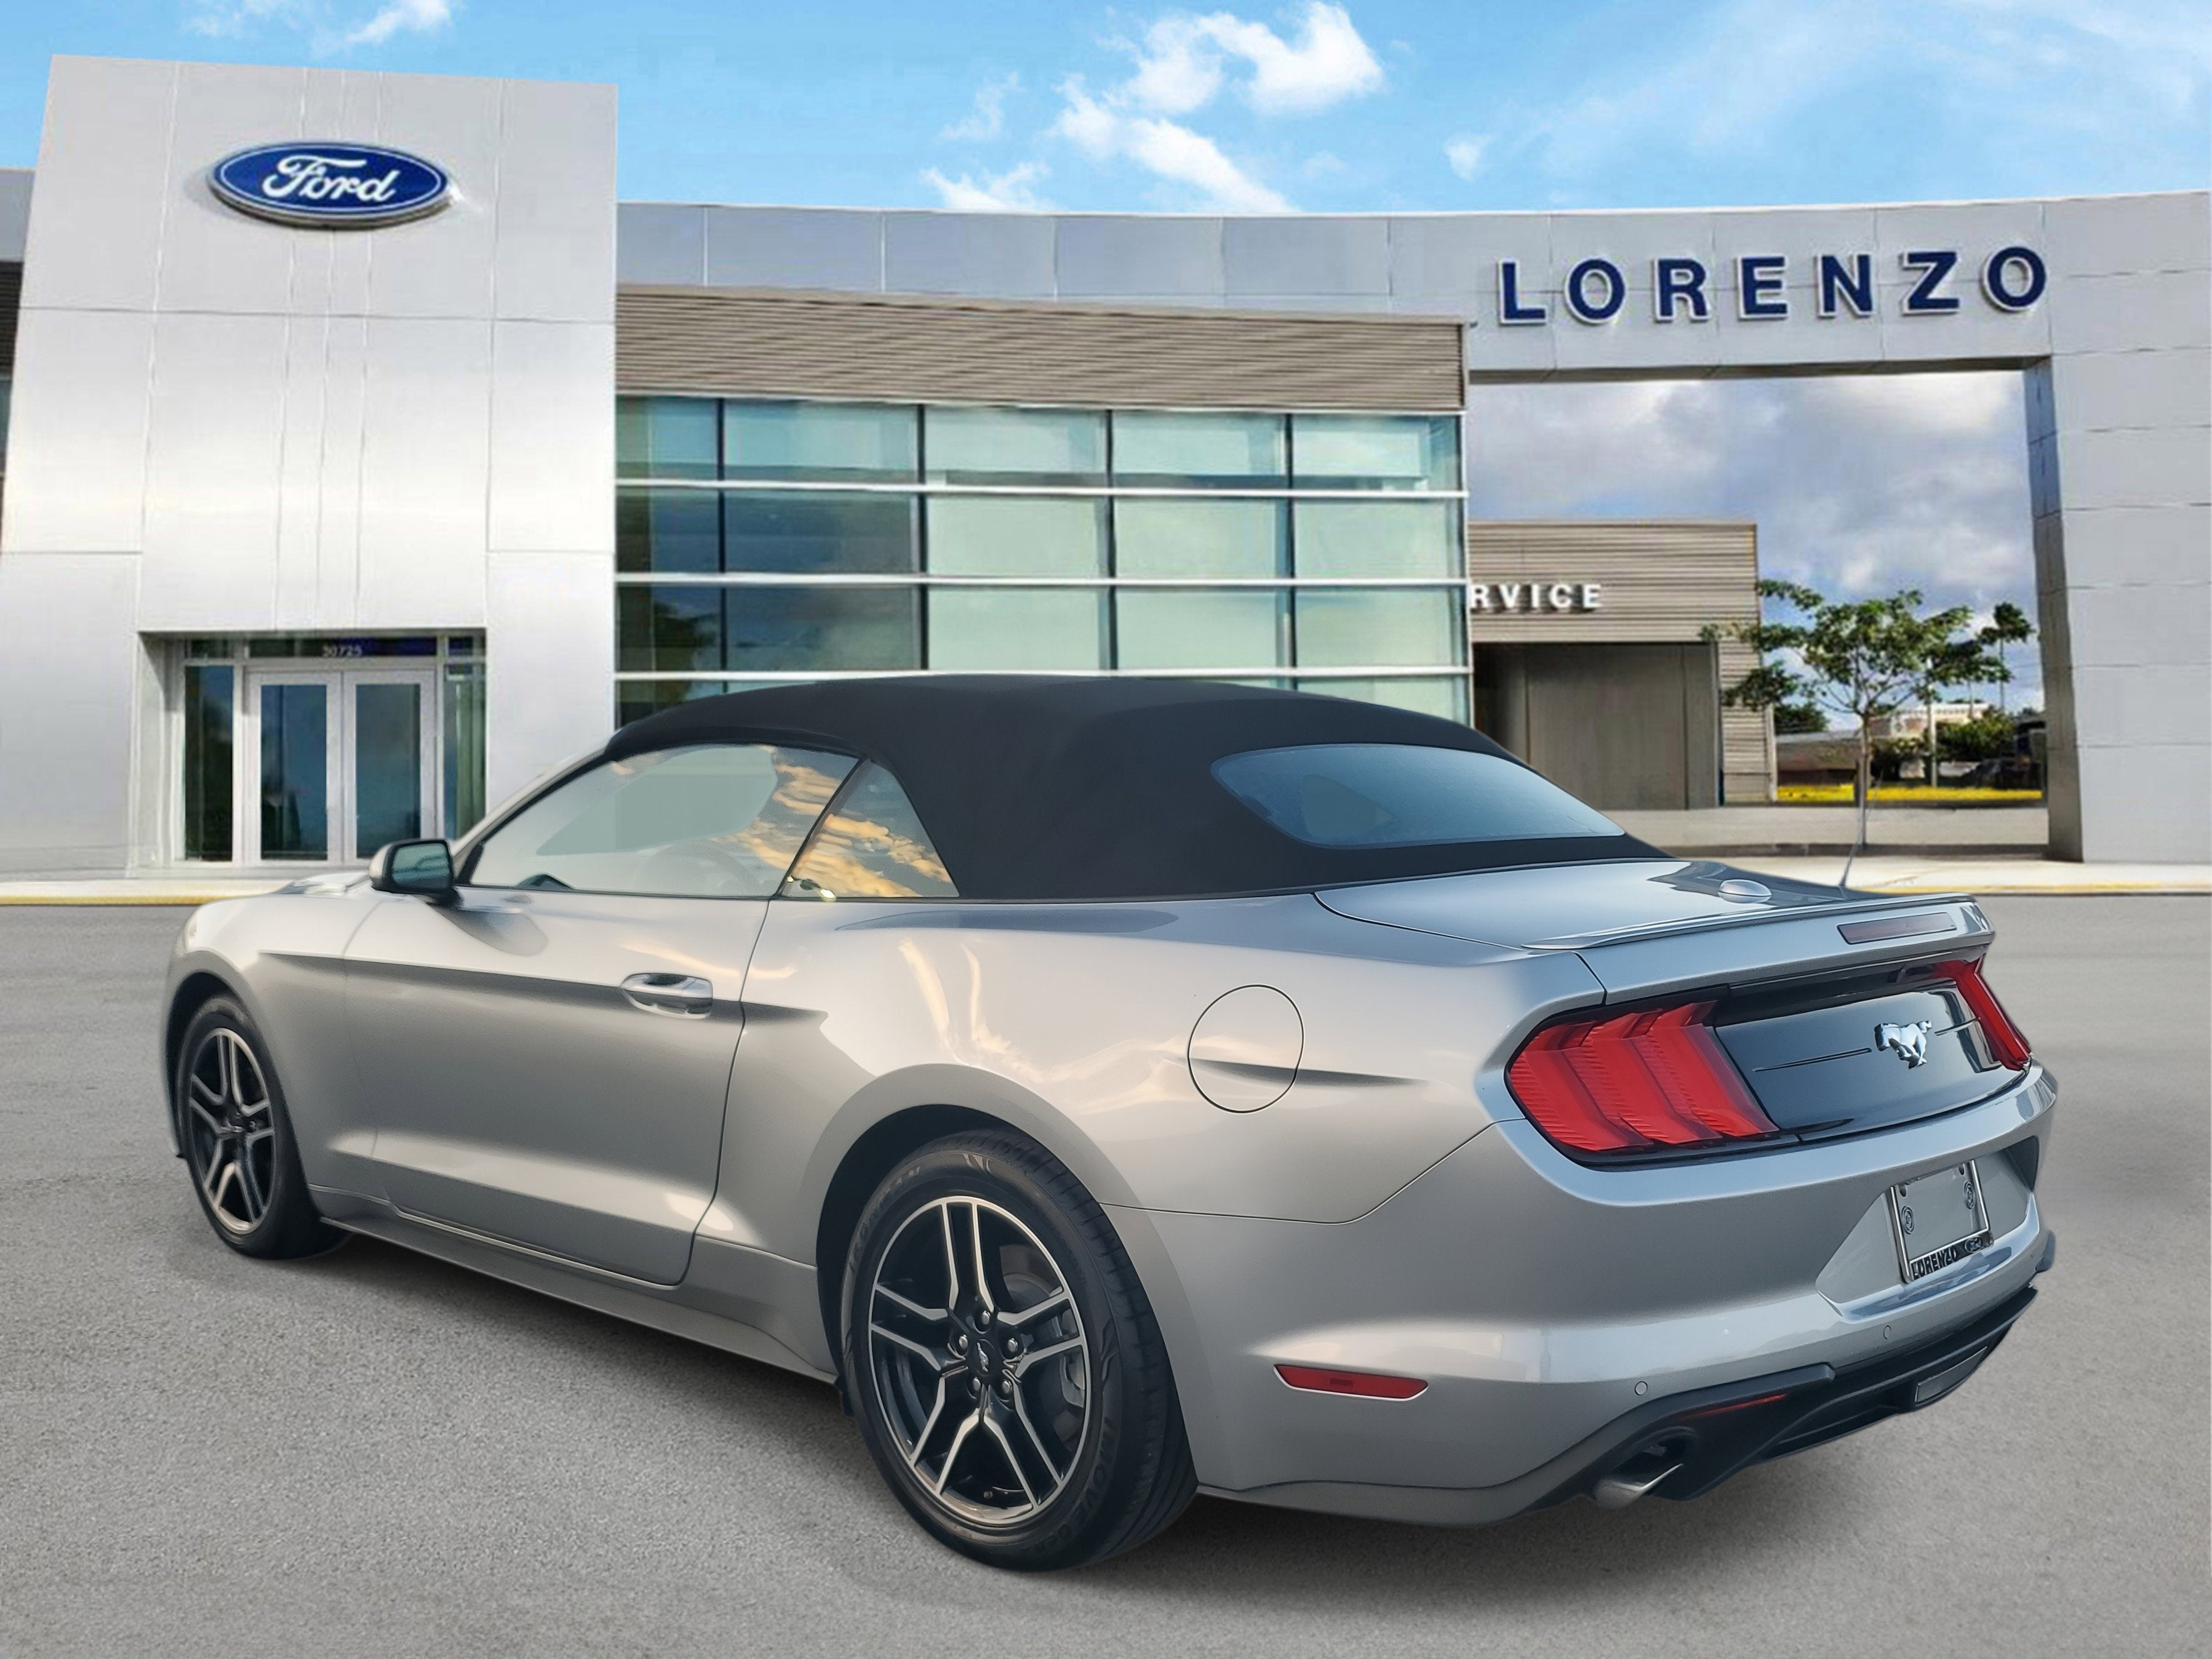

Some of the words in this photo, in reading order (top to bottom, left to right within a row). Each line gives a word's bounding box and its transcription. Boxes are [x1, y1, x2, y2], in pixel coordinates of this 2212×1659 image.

[263, 154, 400, 202] Ford
[1499, 246, 2046, 322] LORENZO
[1470, 584, 1602, 609] RVICE
[1912, 1246, 1958, 1280] LORENZO
